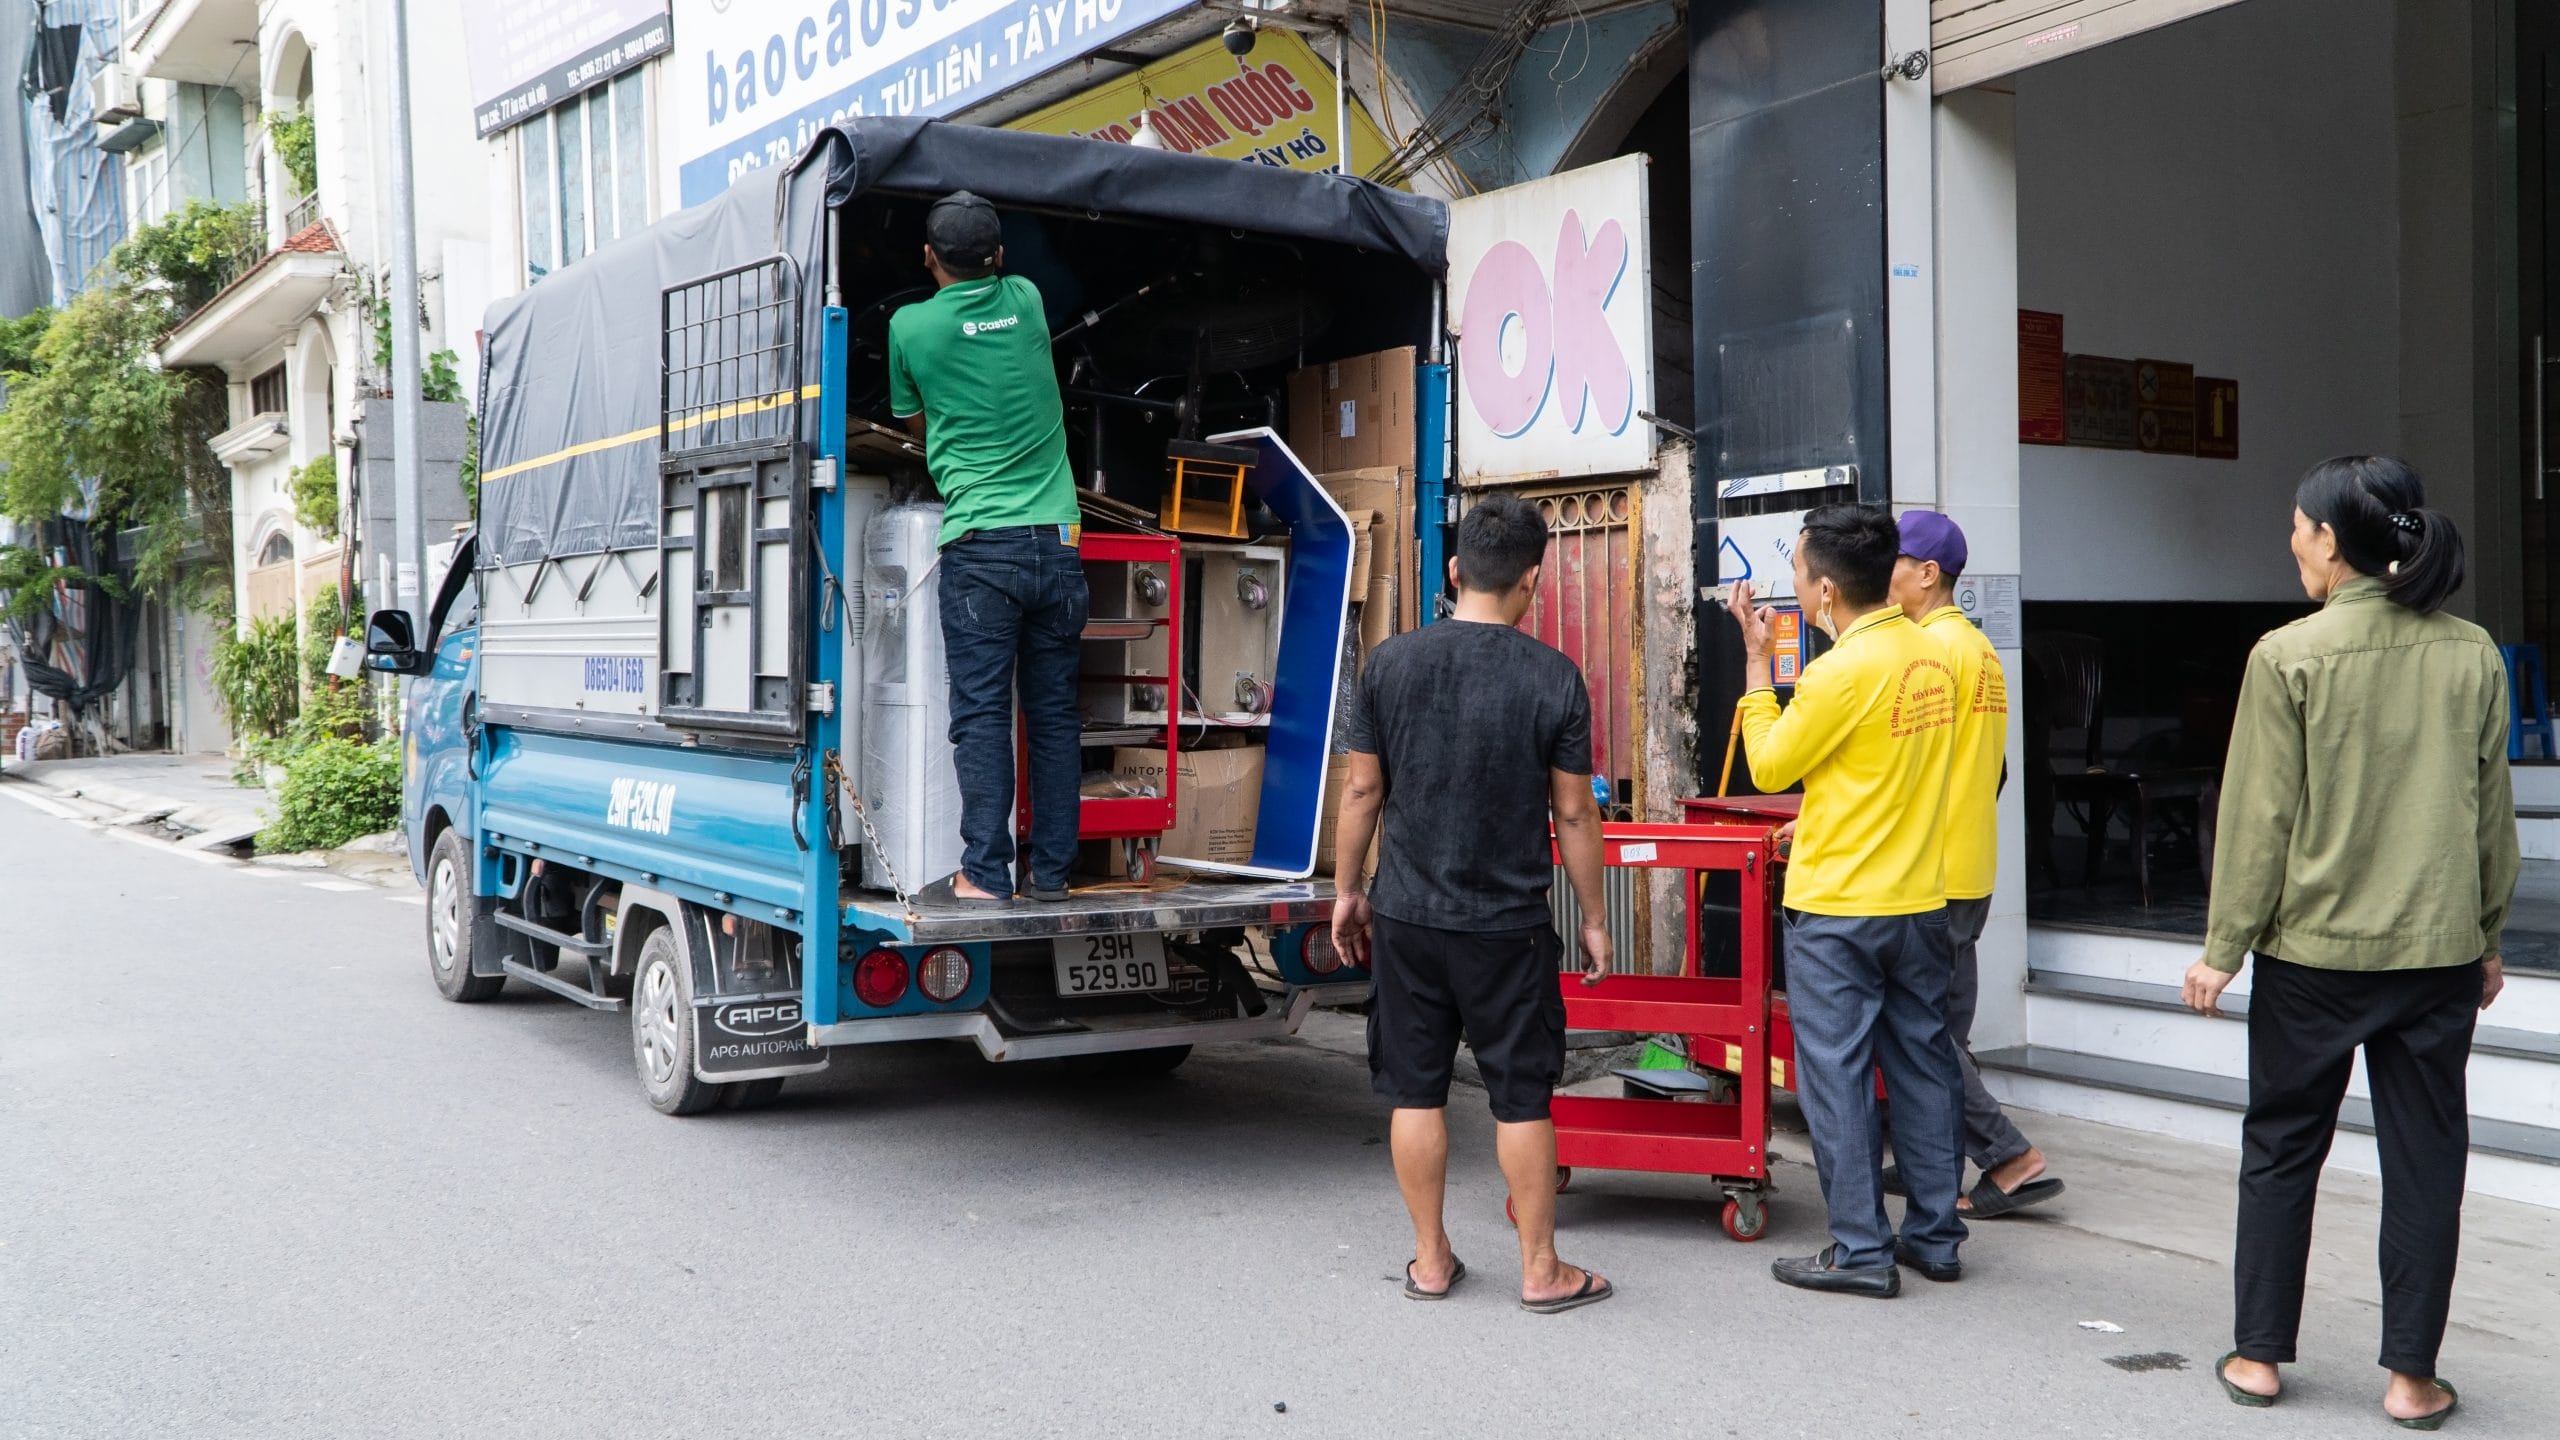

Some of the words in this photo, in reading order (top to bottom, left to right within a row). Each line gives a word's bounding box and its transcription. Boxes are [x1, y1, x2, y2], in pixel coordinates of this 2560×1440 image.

[921, 42, 983, 108] LIÊN
[1004, 1, 1064, 66] TÂY
[501, 98, 510, 121] 77
[1208, 56, 1314, 137] QUỐC
[978, 314, 1018, 332] Castrol
[1460, 207, 1634, 439] OK
[584, 656, 644, 694] 0865041668
[1122, 766, 1168, 776] INTOP
[1085, 934, 1134, 961] 29H
[1068, 962, 1157, 991] 529.90
[729, 1004, 799, 1026] APG
[709, 1044, 739, 1060] APG
[742, 1034, 820, 1058] AUTOPART
